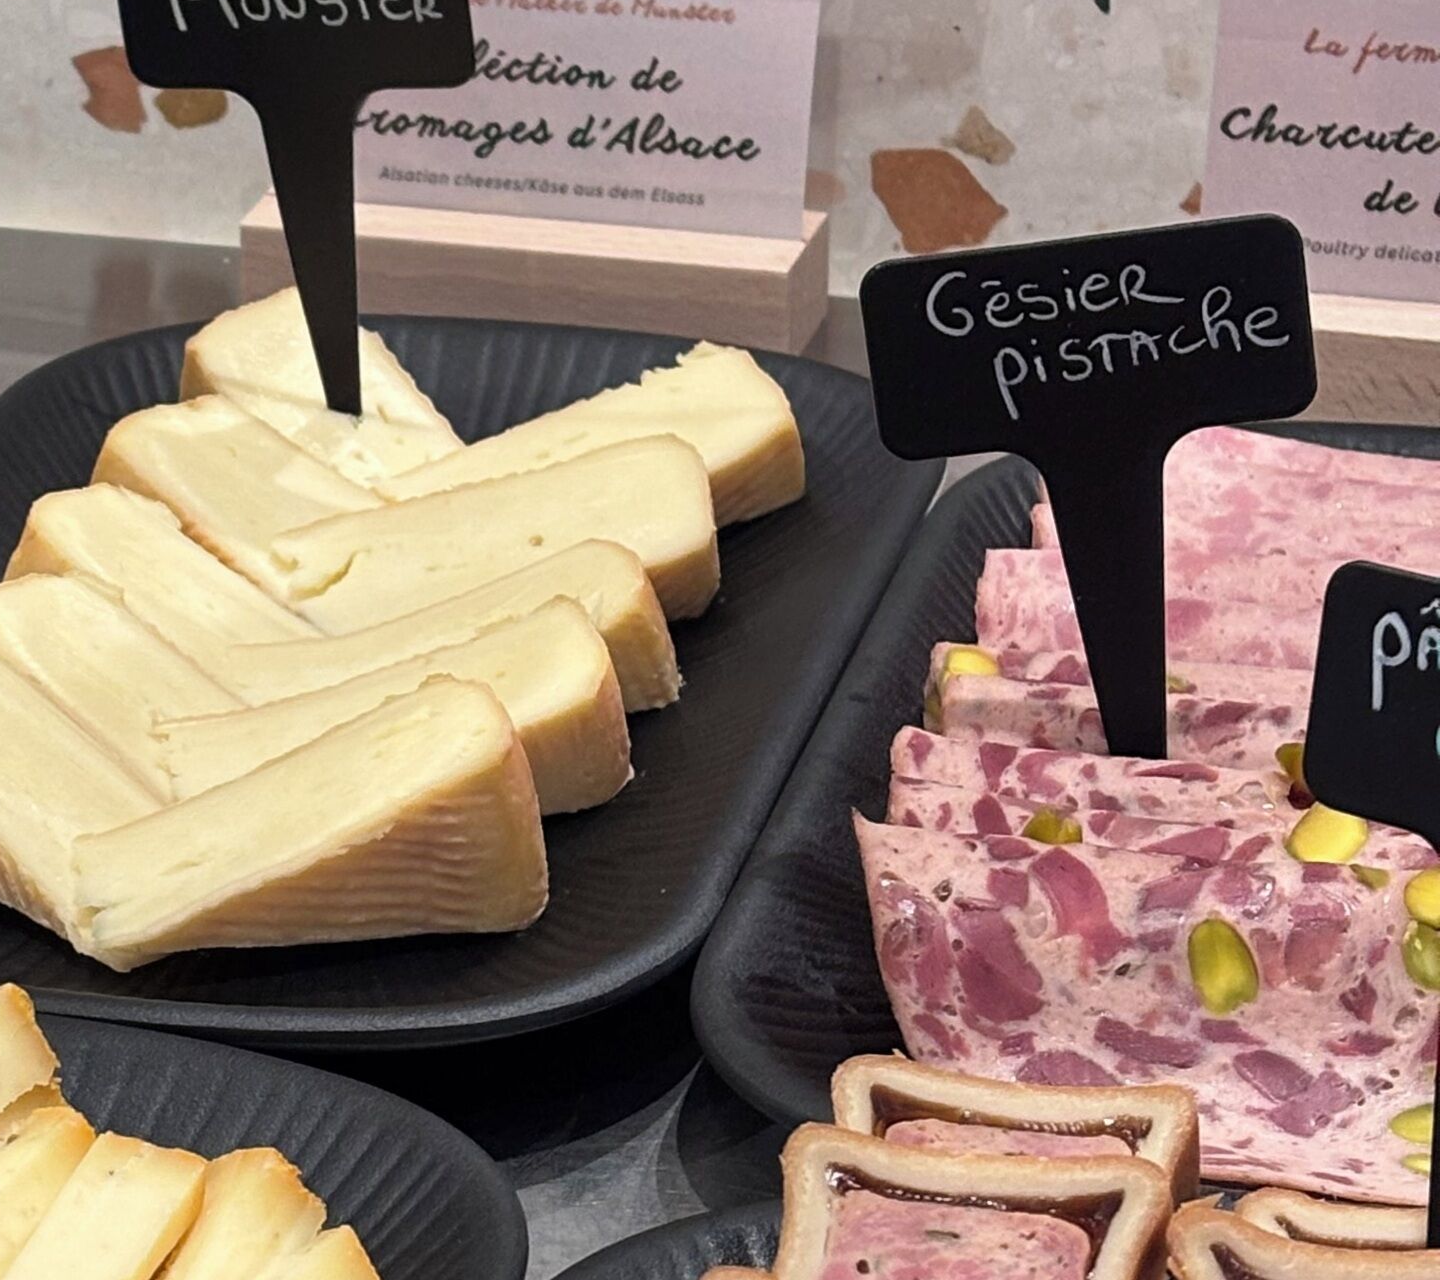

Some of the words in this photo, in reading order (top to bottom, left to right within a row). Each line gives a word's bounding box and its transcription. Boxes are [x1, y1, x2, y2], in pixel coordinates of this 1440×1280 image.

[1304, 28, 1349, 57] La
[474, 38, 617, 90] léction
[630, 56, 684, 93] de
[356, 110, 553, 159] romages
[567, 113, 761, 161] d'Alsace
[379, 166, 451, 185] Alsatian
[573, 182, 604, 197] aus
[609, 184, 646, 200] dem
[650, 187, 706, 206] Elsass
[1363, 178, 1420, 215] de
